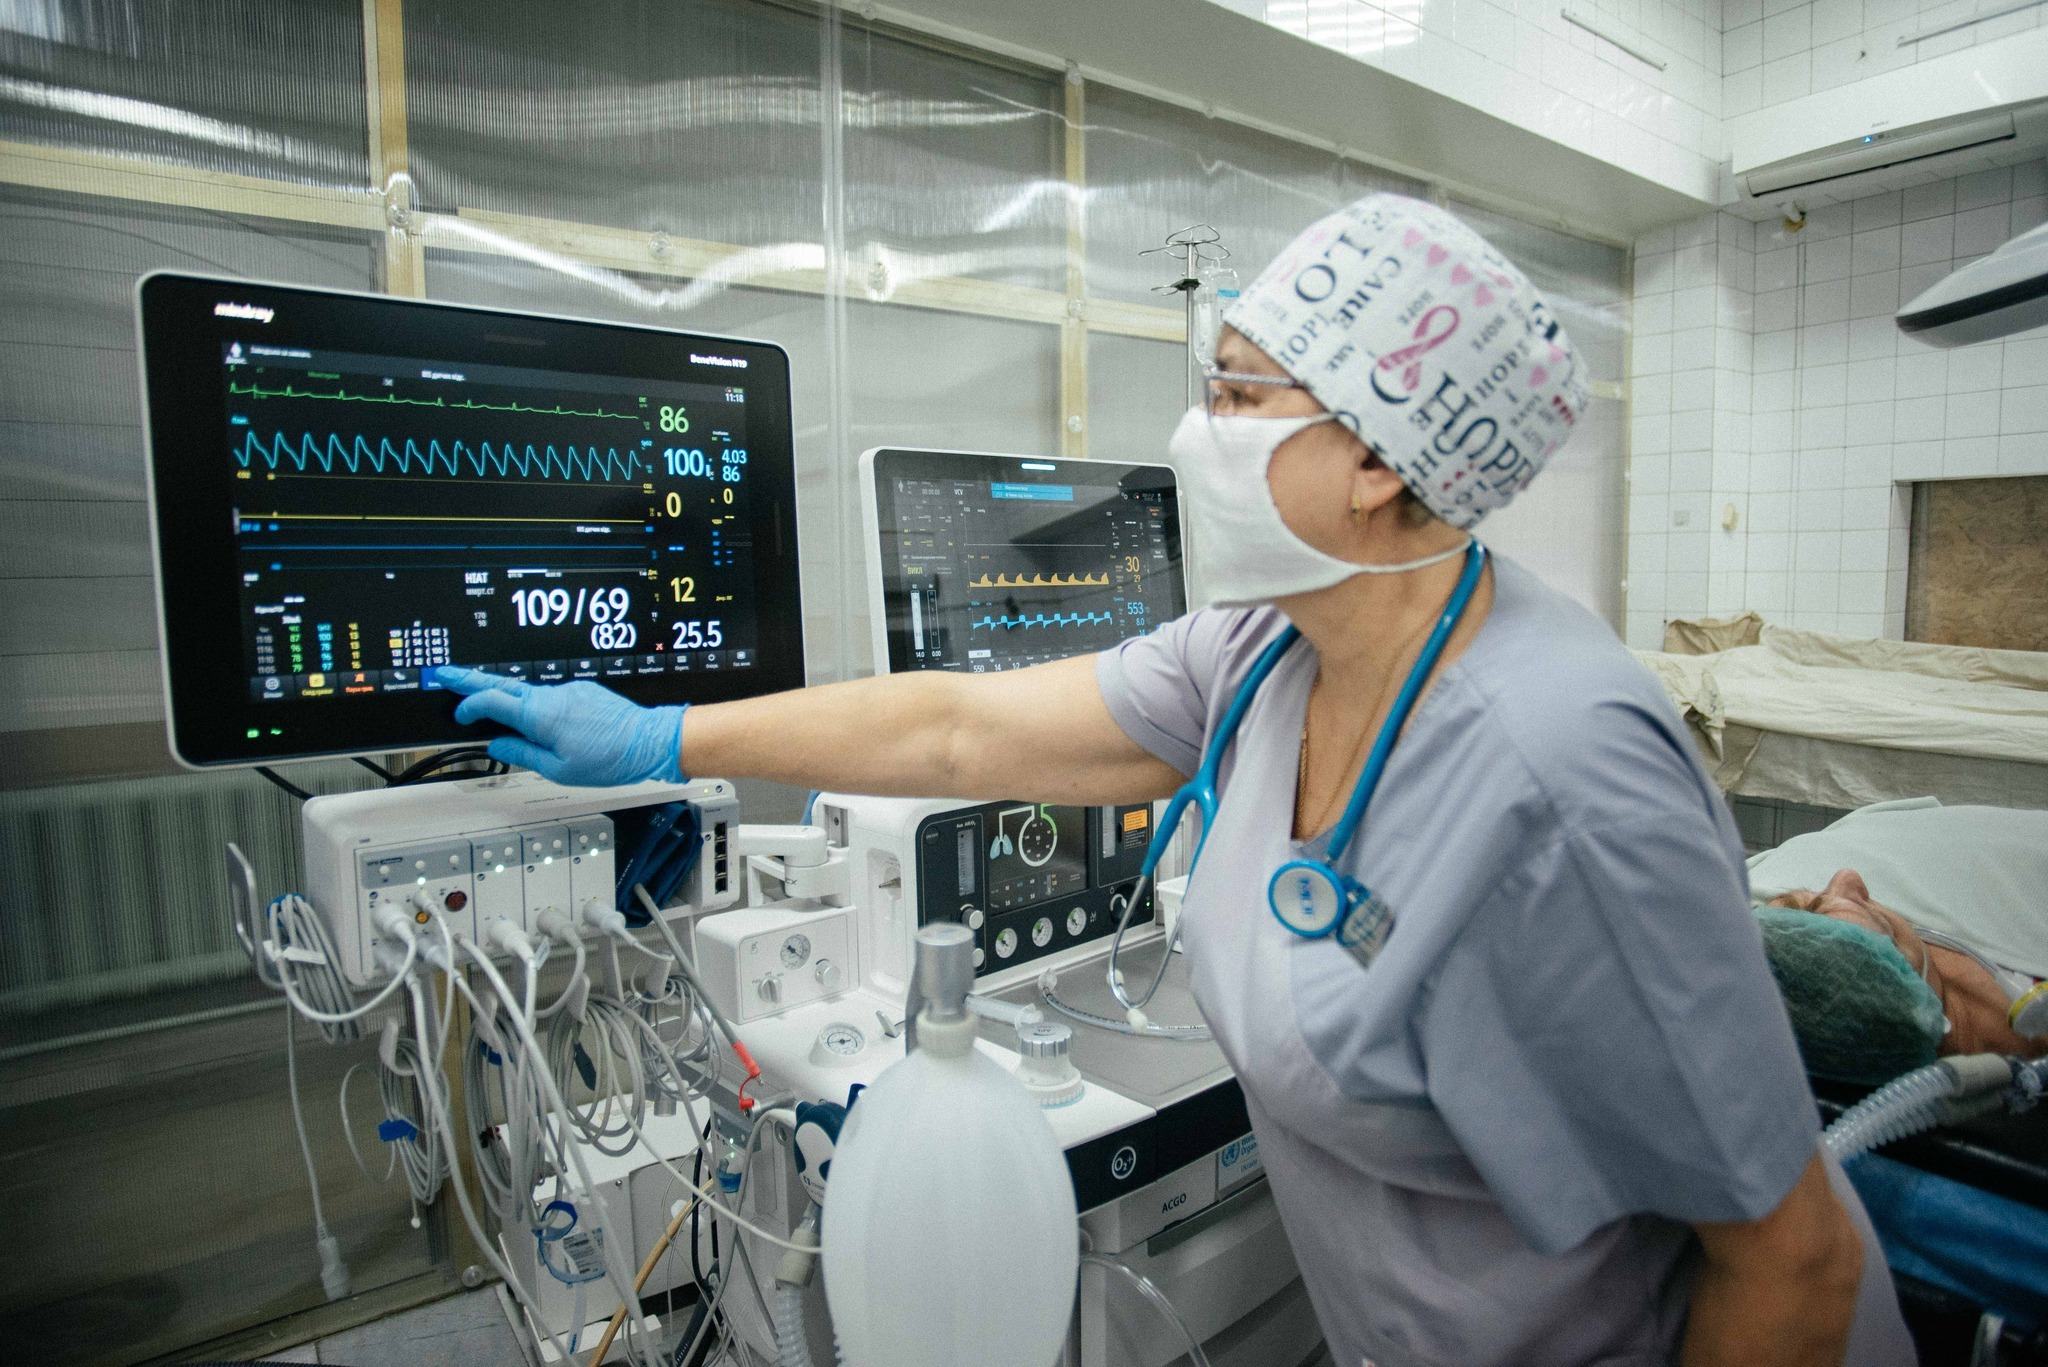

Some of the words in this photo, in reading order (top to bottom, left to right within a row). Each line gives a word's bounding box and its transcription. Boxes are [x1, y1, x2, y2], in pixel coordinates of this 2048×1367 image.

[659, 405, 690, 434] 86
[663, 448, 705, 477] 100
[721, 448, 748, 464] 4.03
[722, 465, 741, 482] 86
[665, 491, 683, 519] 0
[722, 487, 734, 505] 0
[1124, 555, 1140, 573] 30
[670, 576, 697, 603] 12
[1127, 601, 1144, 615] 553
[590, 622, 638, 650] (82)
[672, 620, 723, 651] 25.5
[1161, 1192, 1188, 1214] ACGO
